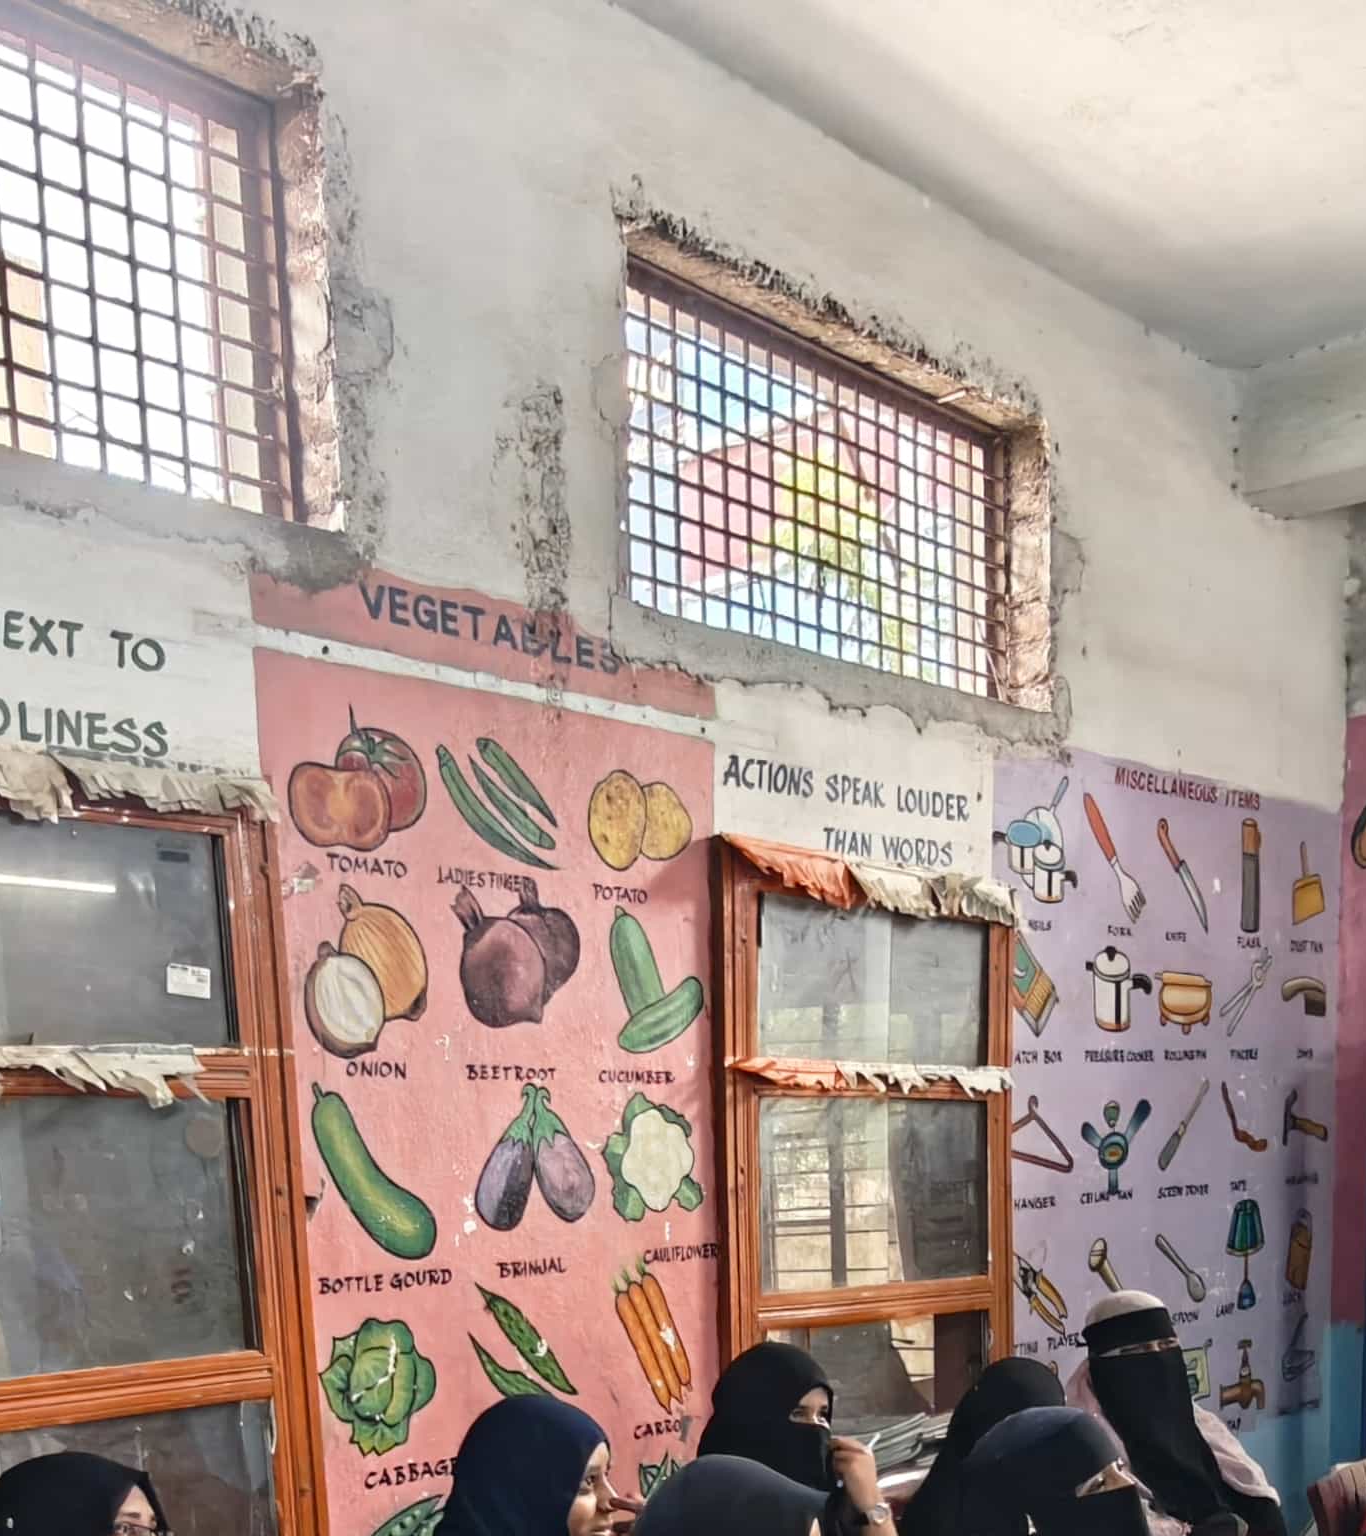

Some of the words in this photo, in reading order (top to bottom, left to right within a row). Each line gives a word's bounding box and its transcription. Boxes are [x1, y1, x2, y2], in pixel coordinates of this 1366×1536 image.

[358, 579, 621, 675] VEGETABLES
[110, 629, 167, 674] TO
[723, 755, 814, 799] ACTIONS
[825, 774, 887, 809] SPEAK
[896, 785, 971, 823] LOUDER
[1115, 767, 1218, 804] MISCELLANEOUS
[1224, 789, 1261, 812] ITEMS
[823, 827, 873, 859] THAN
[881, 834, 954, 868] WORDS
[326, 852, 409, 880] TOMATO
[592, 883, 649, 906] POTATO
[345, 1060, 408, 1080] ONION
[465, 1063, 557, 1082] BEETROOT
[598, 1069, 676, 1085] CUCUMBER
[643, 1242, 719, 1266] CAULIFLOWER
[318, 1274, 386, 1295] BOTTLE
[390, 1268, 453, 1290] GOURD
[496, 1257, 567, 1279] BRINJAL
